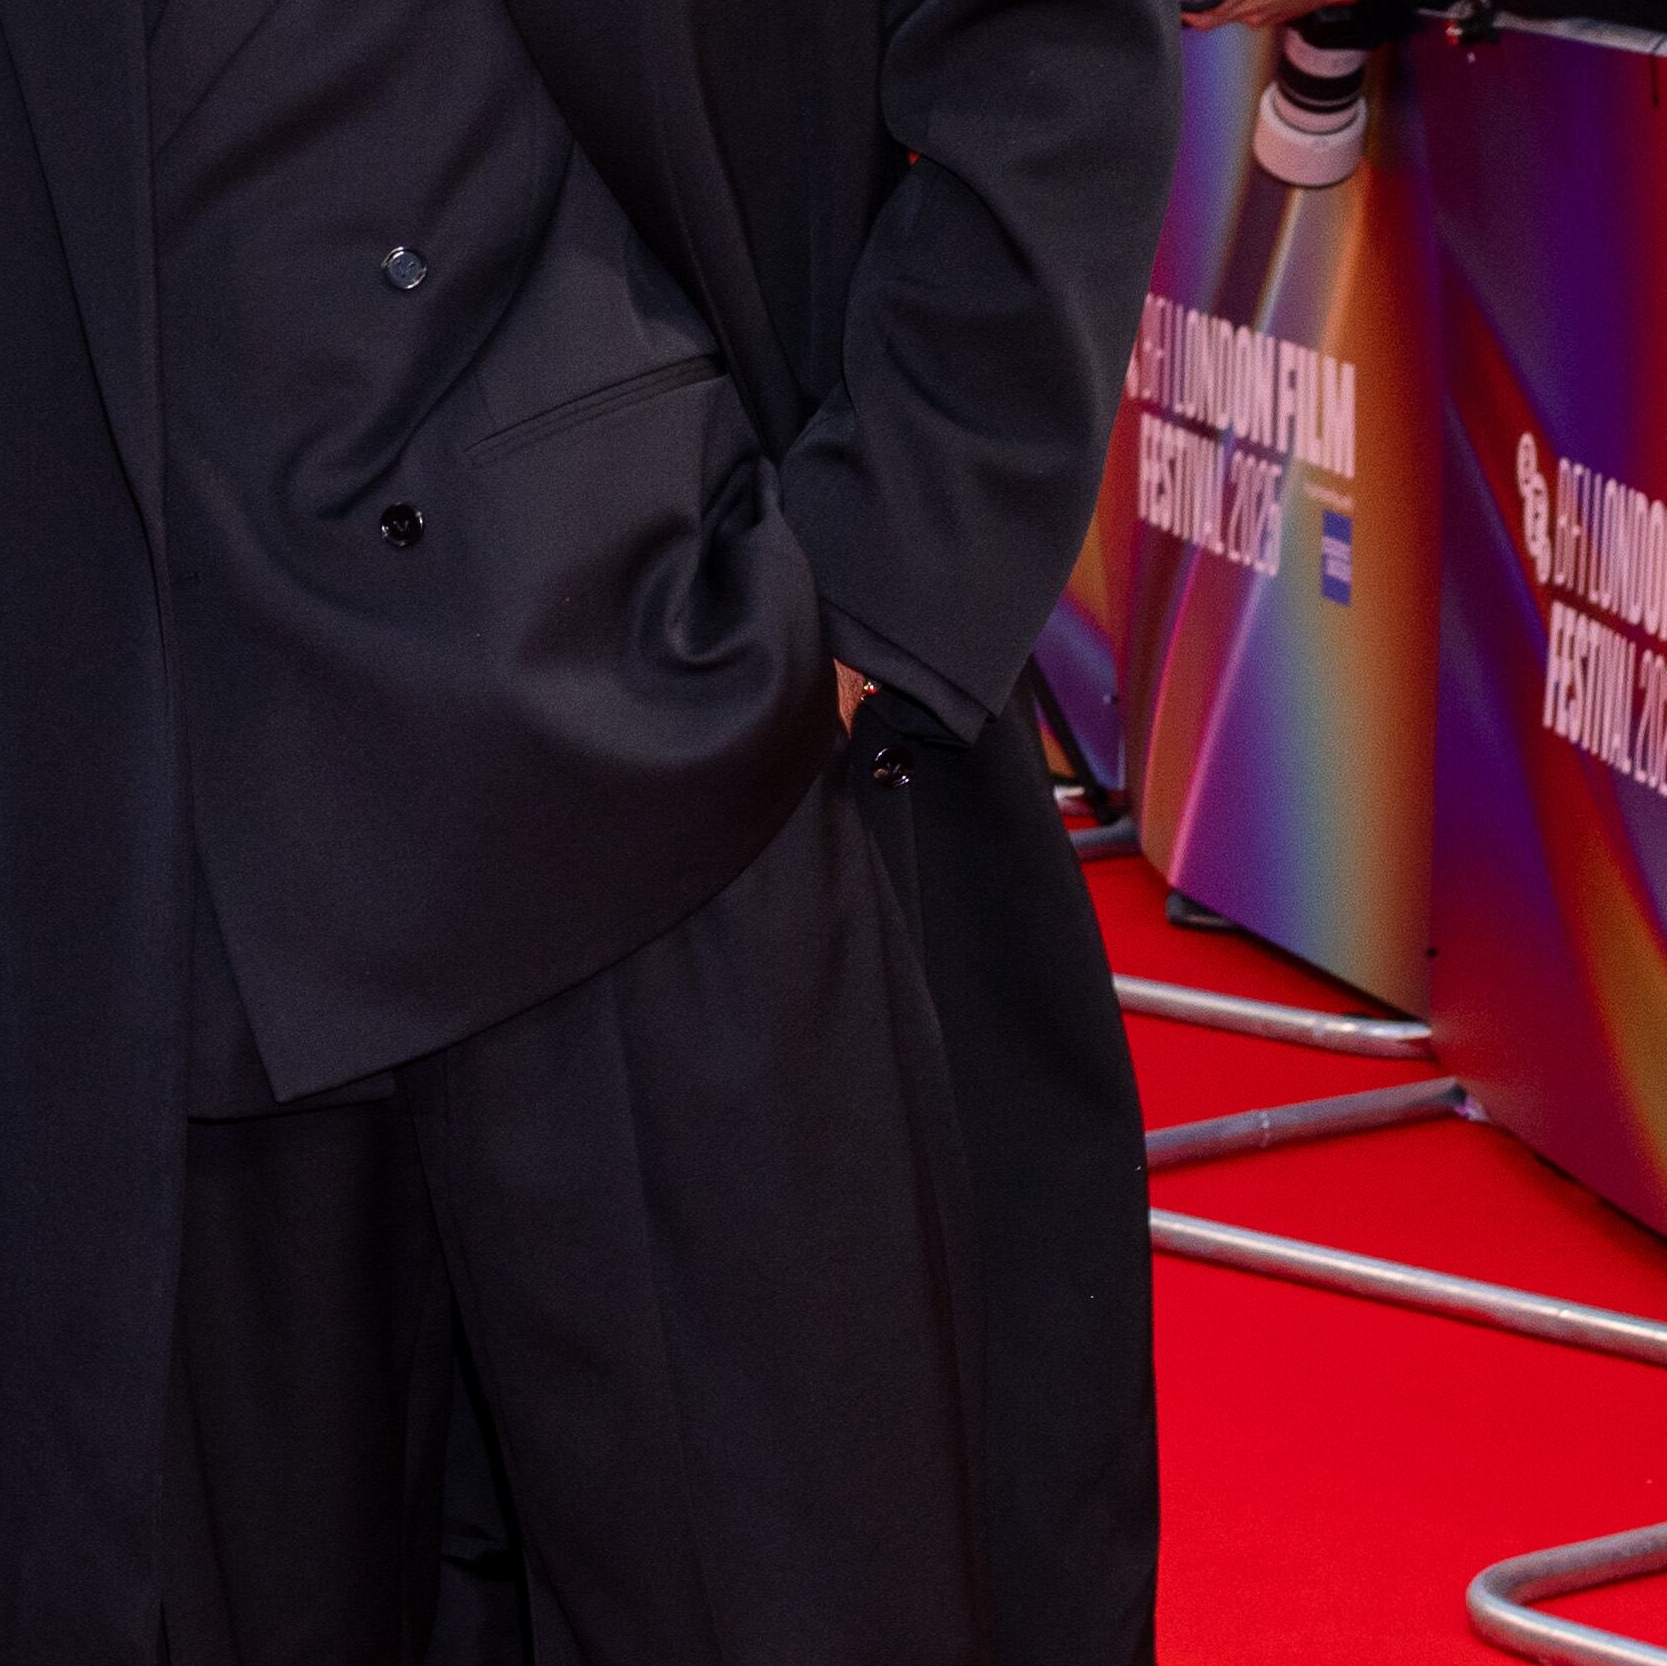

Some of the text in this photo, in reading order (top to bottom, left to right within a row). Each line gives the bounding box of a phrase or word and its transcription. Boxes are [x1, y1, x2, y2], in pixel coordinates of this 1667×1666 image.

[1173, 303, 1277, 449] LONDON
[1277, 337, 1356, 480] FILM
[1138, 410, 1283, 577] FESTIVAL 2025
[1542, 597, 1638, 775] FESTIVAL
